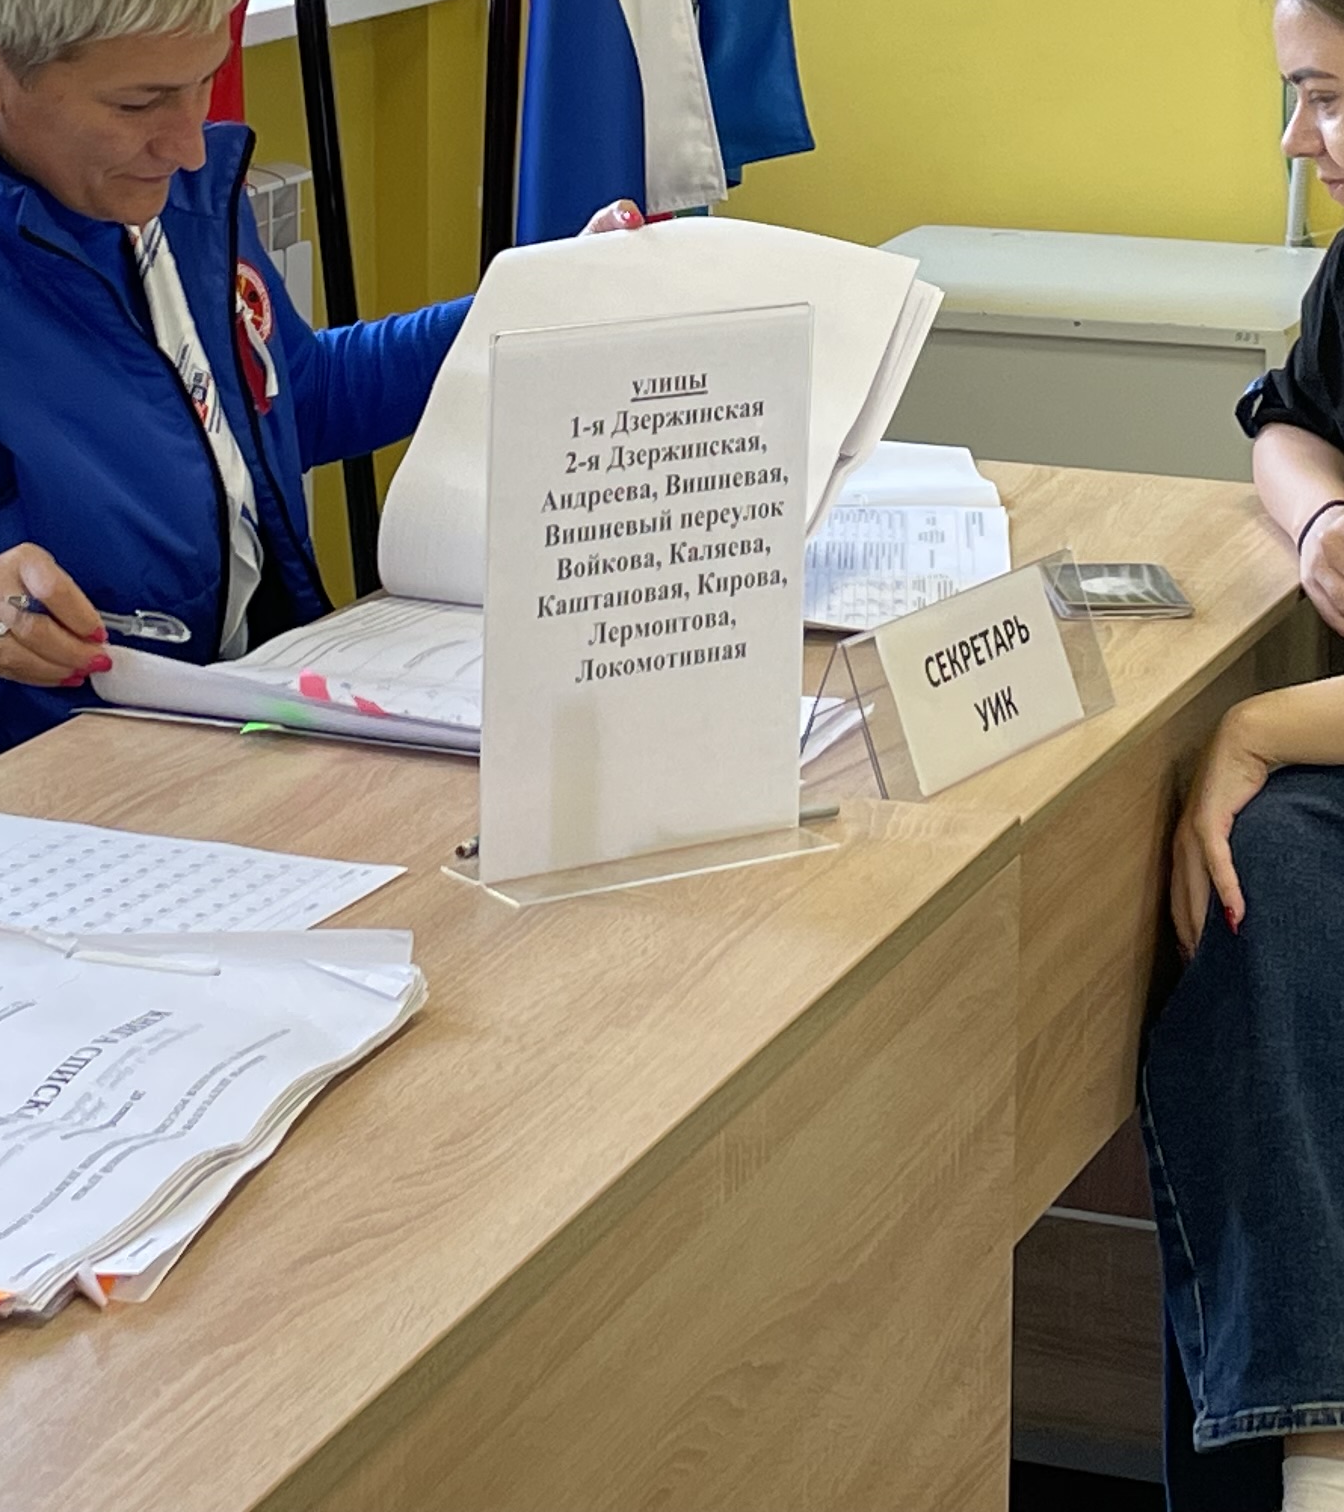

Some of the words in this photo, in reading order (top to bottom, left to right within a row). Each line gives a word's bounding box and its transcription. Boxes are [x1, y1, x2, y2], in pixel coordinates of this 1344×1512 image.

[630, 373, 709, 403] улицы
[572, 416, 605, 439] 1-я
[610, 401, 764, 438] Дзержинская
[565, 451, 600, 474] 2-я
[606, 435, 767, 473] Дзержинская,
[541, 483, 658, 513] Андреева,
[665, 467, 789, 497] Вишневая,
[544, 509, 672, 548] Вишневый
[680, 501, 785, 532] переулок
[556, 552, 662, 581] Войкова,
[669, 537, 771, 565] Каляева,
[537, 582, 690, 619] Каштановая,
[697, 569, 788, 598] Кирова,
[588, 610, 737, 648] Лермонтова,
[574, 642, 747, 684] Локомотивная
[924, 615, 1030, 688] СЕКРЕТАРЬ
[973, 685, 1019, 733] УИК
